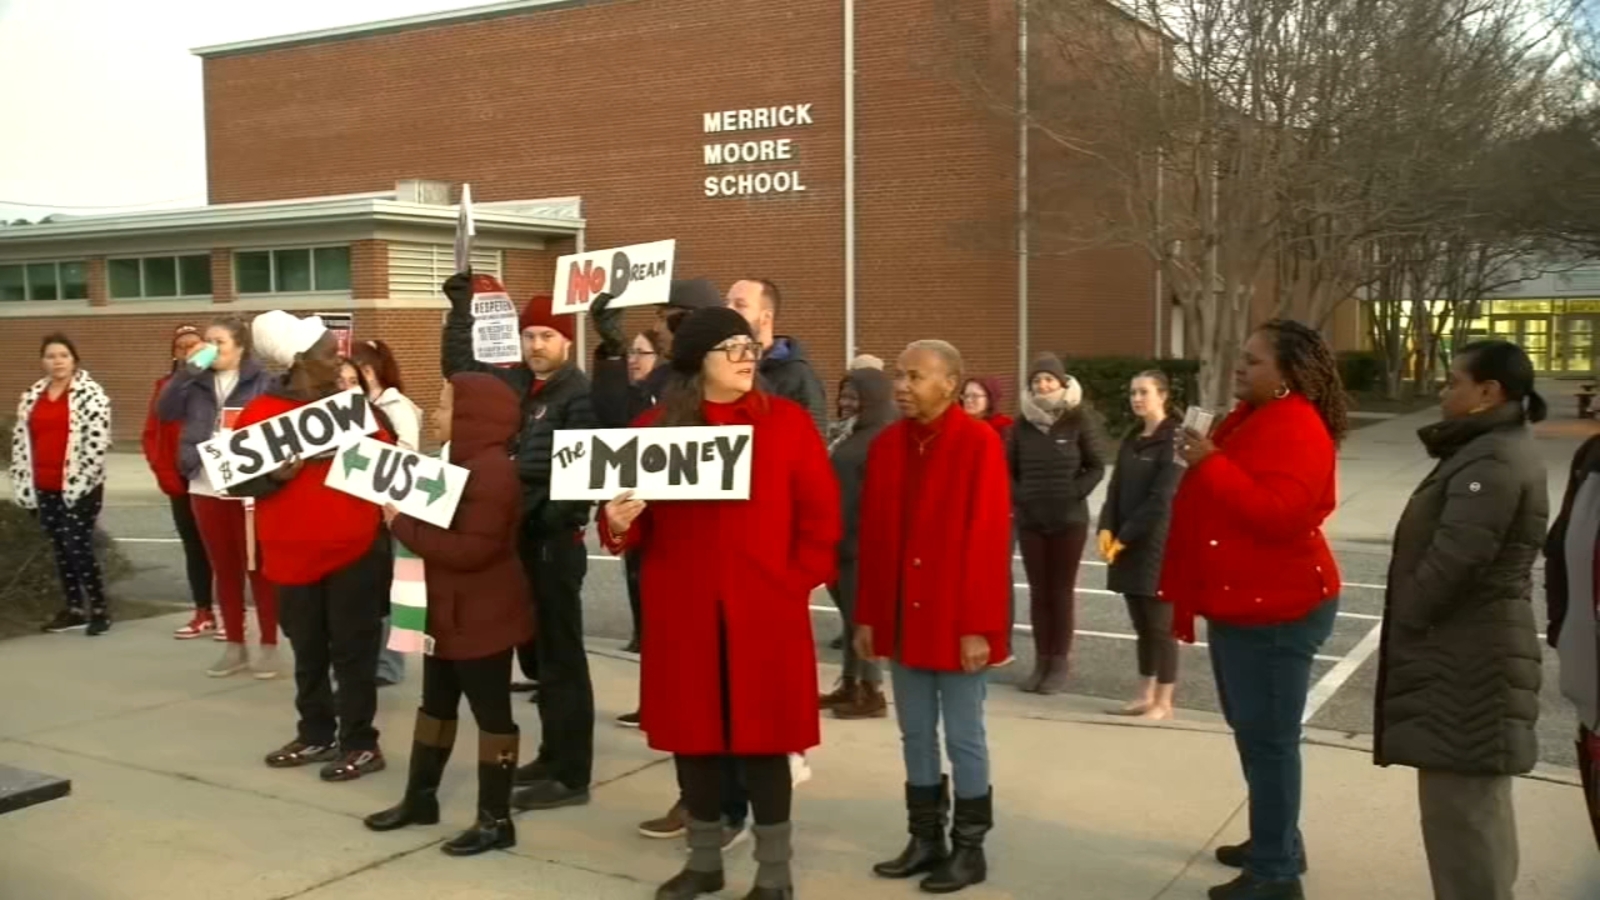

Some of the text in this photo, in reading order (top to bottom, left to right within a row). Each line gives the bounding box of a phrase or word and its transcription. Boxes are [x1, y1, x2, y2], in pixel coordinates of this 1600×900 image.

[703, 103, 813, 132] MERRICK
[704, 138, 792, 165] MOORE
[704, 171, 807, 197] SCHOOL
[609, 251, 667, 299] DREAM
[229, 393, 368, 475] SHOW
[372, 448, 420, 501] US
[553, 434, 750, 490] The MONEY
